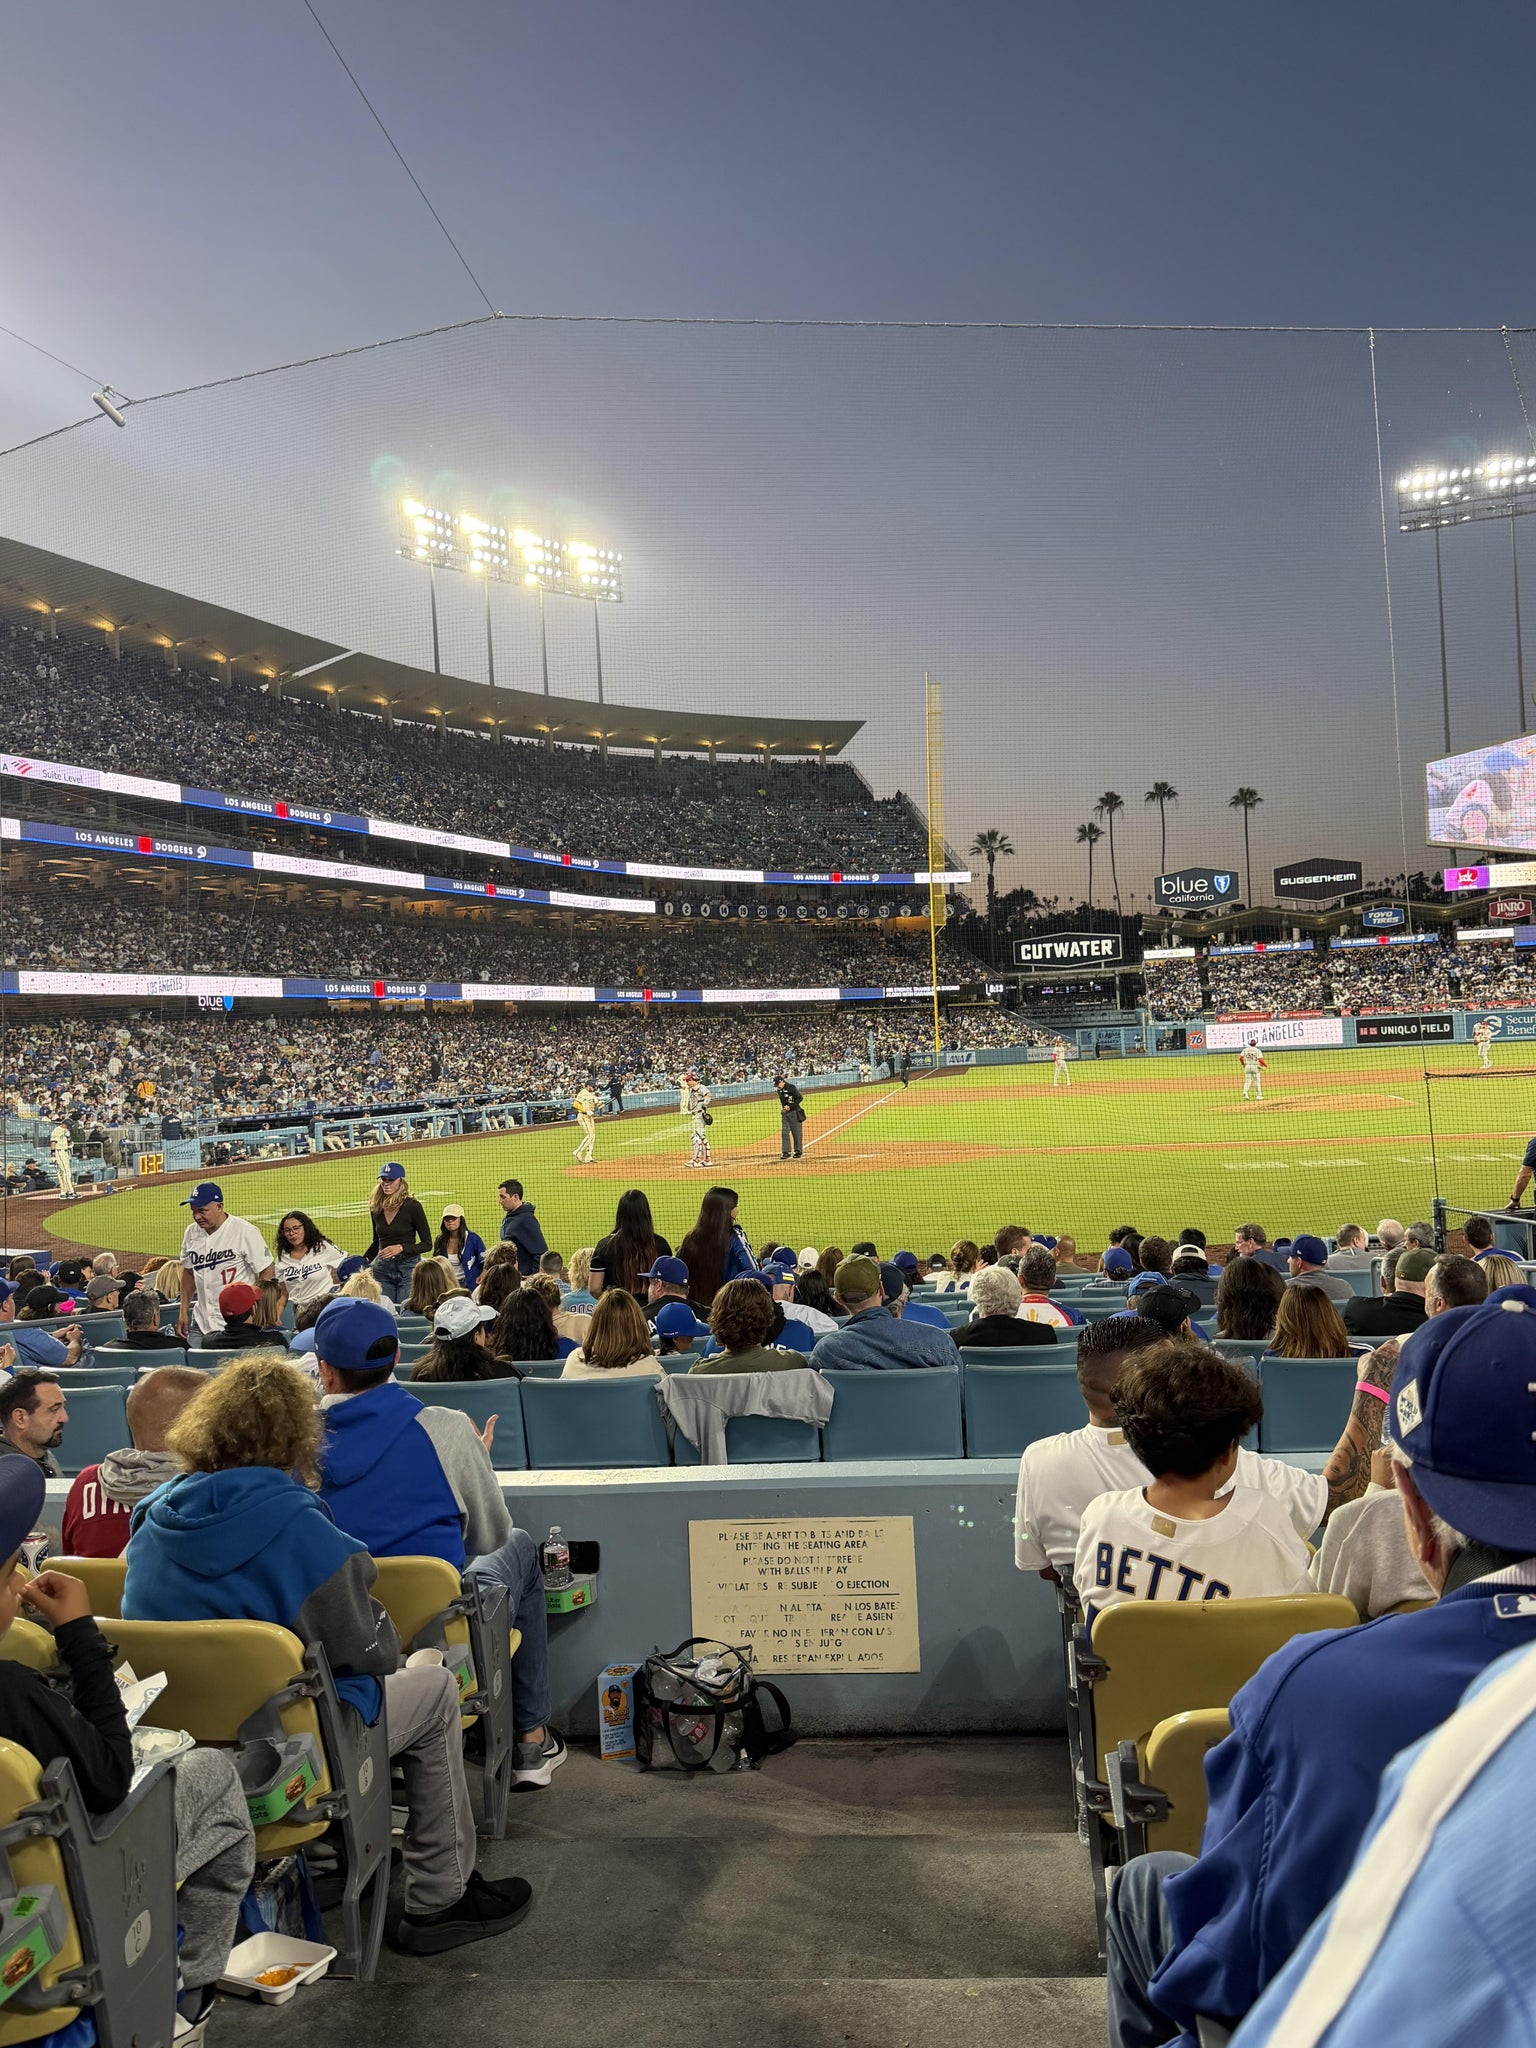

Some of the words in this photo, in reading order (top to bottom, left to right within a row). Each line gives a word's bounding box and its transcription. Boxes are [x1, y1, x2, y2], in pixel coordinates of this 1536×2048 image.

[42, 769, 61, 780] Suite
[64, 773, 83, 784] Level
[225, 797, 239, 806] LOS
[241, 800, 273, 813] ANGELES
[290, 808, 321, 821] DODGERS
[75, 832, 92, 842] LOS
[95, 835, 134, 848] ANGELES
[155, 842, 193, 855] DODGERS
[1280, 873, 1356, 885] GUGGENHEIM
[1161, 877, 1209, 895] blue
[1169, 893, 1215, 903] california
[1496, 902, 1525, 915] JINRO
[1021, 939, 1113, 960] CUTWATER
[325, 984, 339, 993] LOS
[340, 984, 371, 993] ANGELES
[387, 985, 416, 994] DODGERS
[198, 995, 223, 1006] blue
[1242, 1028, 1259, 1044] LOS
[1262, 1022, 1304, 1043] ANGELES
[1381, 1024, 1418, 1035] UNIQLO
[1421, 1022, 1450, 1033] FIELD
[1189, 1034, 1203, 1044] 76
[190, 1248, 236, 1270] Dodgers
[221, 1267, 237, 1285] 17
[284, 1263, 322, 1280] Dodgers
[719, 1532, 749, 1541] PLASE
[795, 1531, 807, 1539] TO
[810, 1531, 831, 1539] BTS
[858, 1529, 884, 1538] BALS
[736, 1542, 780, 1551] ENTING
[784, 1541, 799, 1550] THE
[802, 1540, 841, 1549] SEATING
[844, 1540, 868, 1548] AREA
[777, 1556, 791, 1565] DO
[794, 1556, 814, 1565] NOT
[758, 1567, 781, 1576] WTH
[826, 1566, 848, 1574] PAY
[718, 1582, 768, 1591] VILATRS
[791, 1581, 819, 1590] SUBJE
[847, 1580, 890, 1589] EJECTION
[855, 1603, 873, 1611] LOS
[866, 1612, 897, 1621] ASIEN
[740, 1629, 768, 1638] FAVR
[773, 1629, 787, 1638] NO
[852, 1628, 873, 1636] CON
[820, 1638, 843, 1647] JUG
[132, 1920, 142, 1940] 10
[135, 1938, 142, 1953] C
